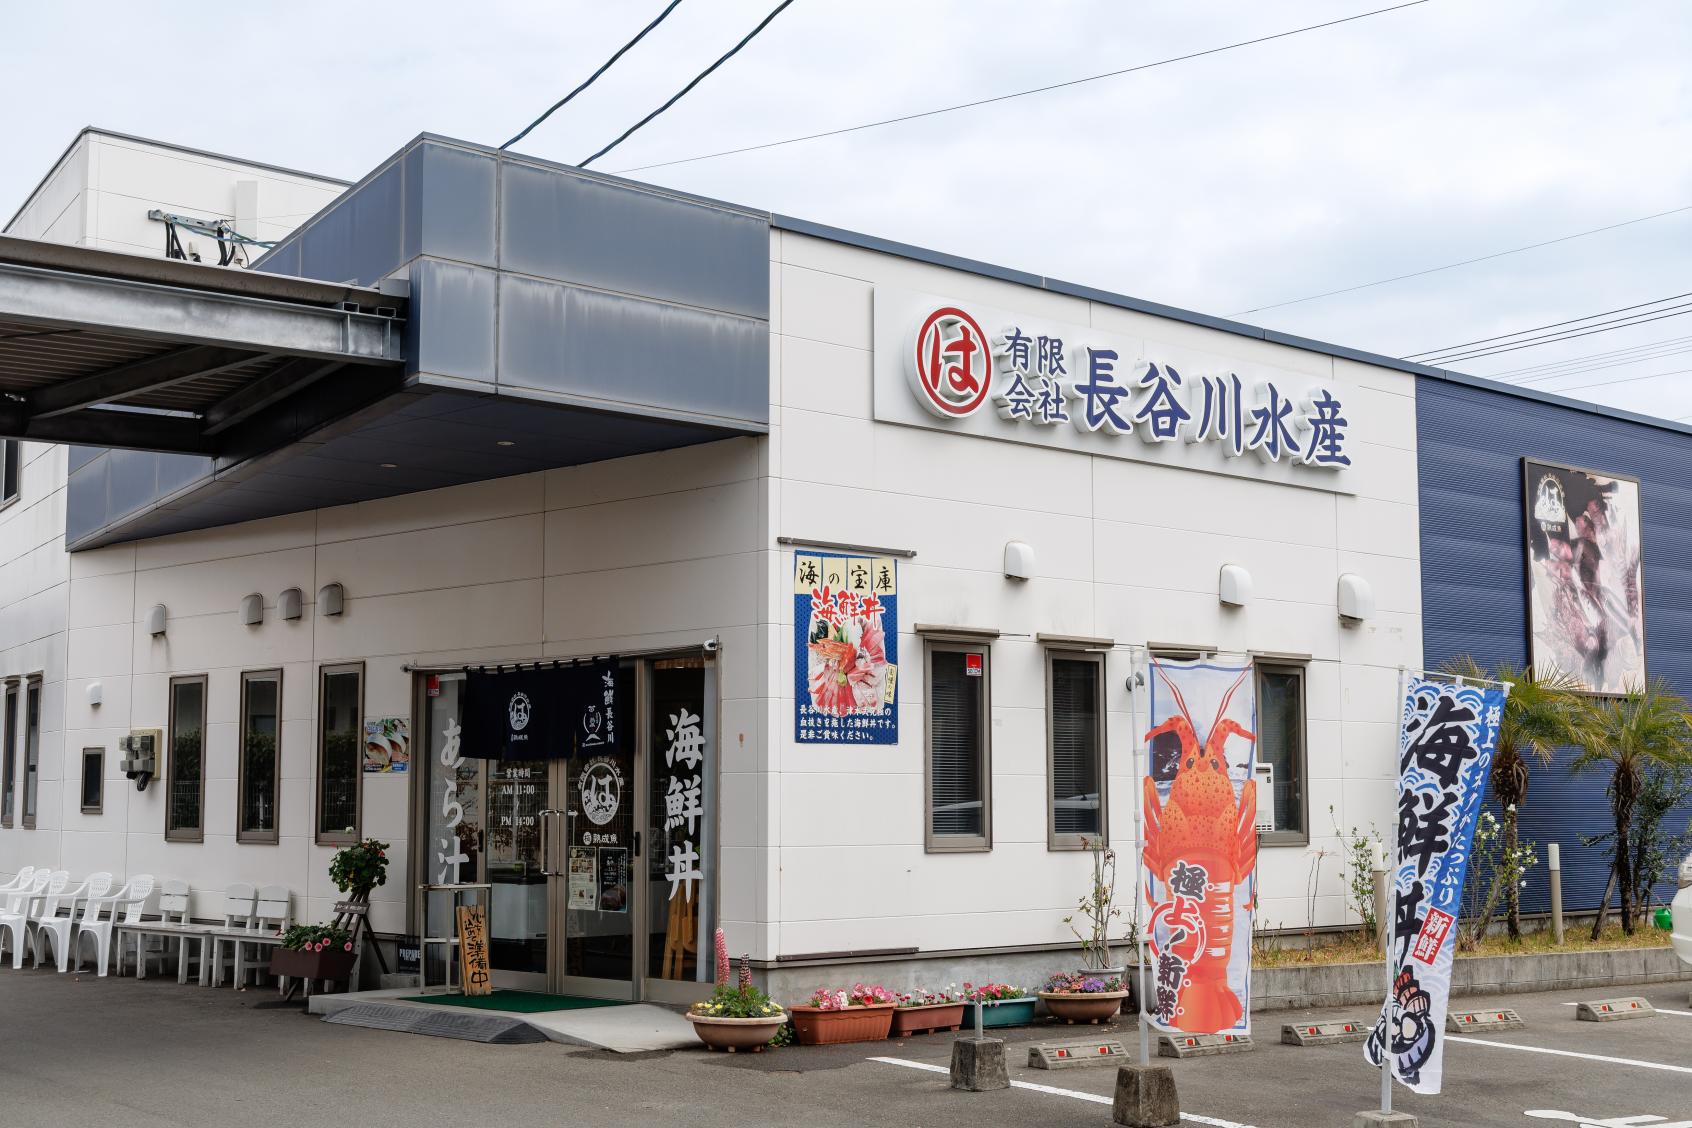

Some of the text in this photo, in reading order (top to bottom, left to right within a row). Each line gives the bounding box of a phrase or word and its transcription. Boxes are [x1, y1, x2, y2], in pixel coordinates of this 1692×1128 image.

[1005, 327, 1067, 376] 有限
[1004, 377, 1069, 422] 会社
[1074, 346, 1352, 467] 長谷川水産
[799, 560, 893, 592] 海の宝庫
[812, 585, 885, 630] 海鮮丼
[438, 717, 469, 884] あら汁
[502, 784, 535, 795] AM 11:00
[664, 708, 706, 903] 海鮮丼
[501, 815, 512, 826] PM
[1395, 694, 1478, 968] 海鮮丼
[1415, 911, 1450, 961] 新鮮
